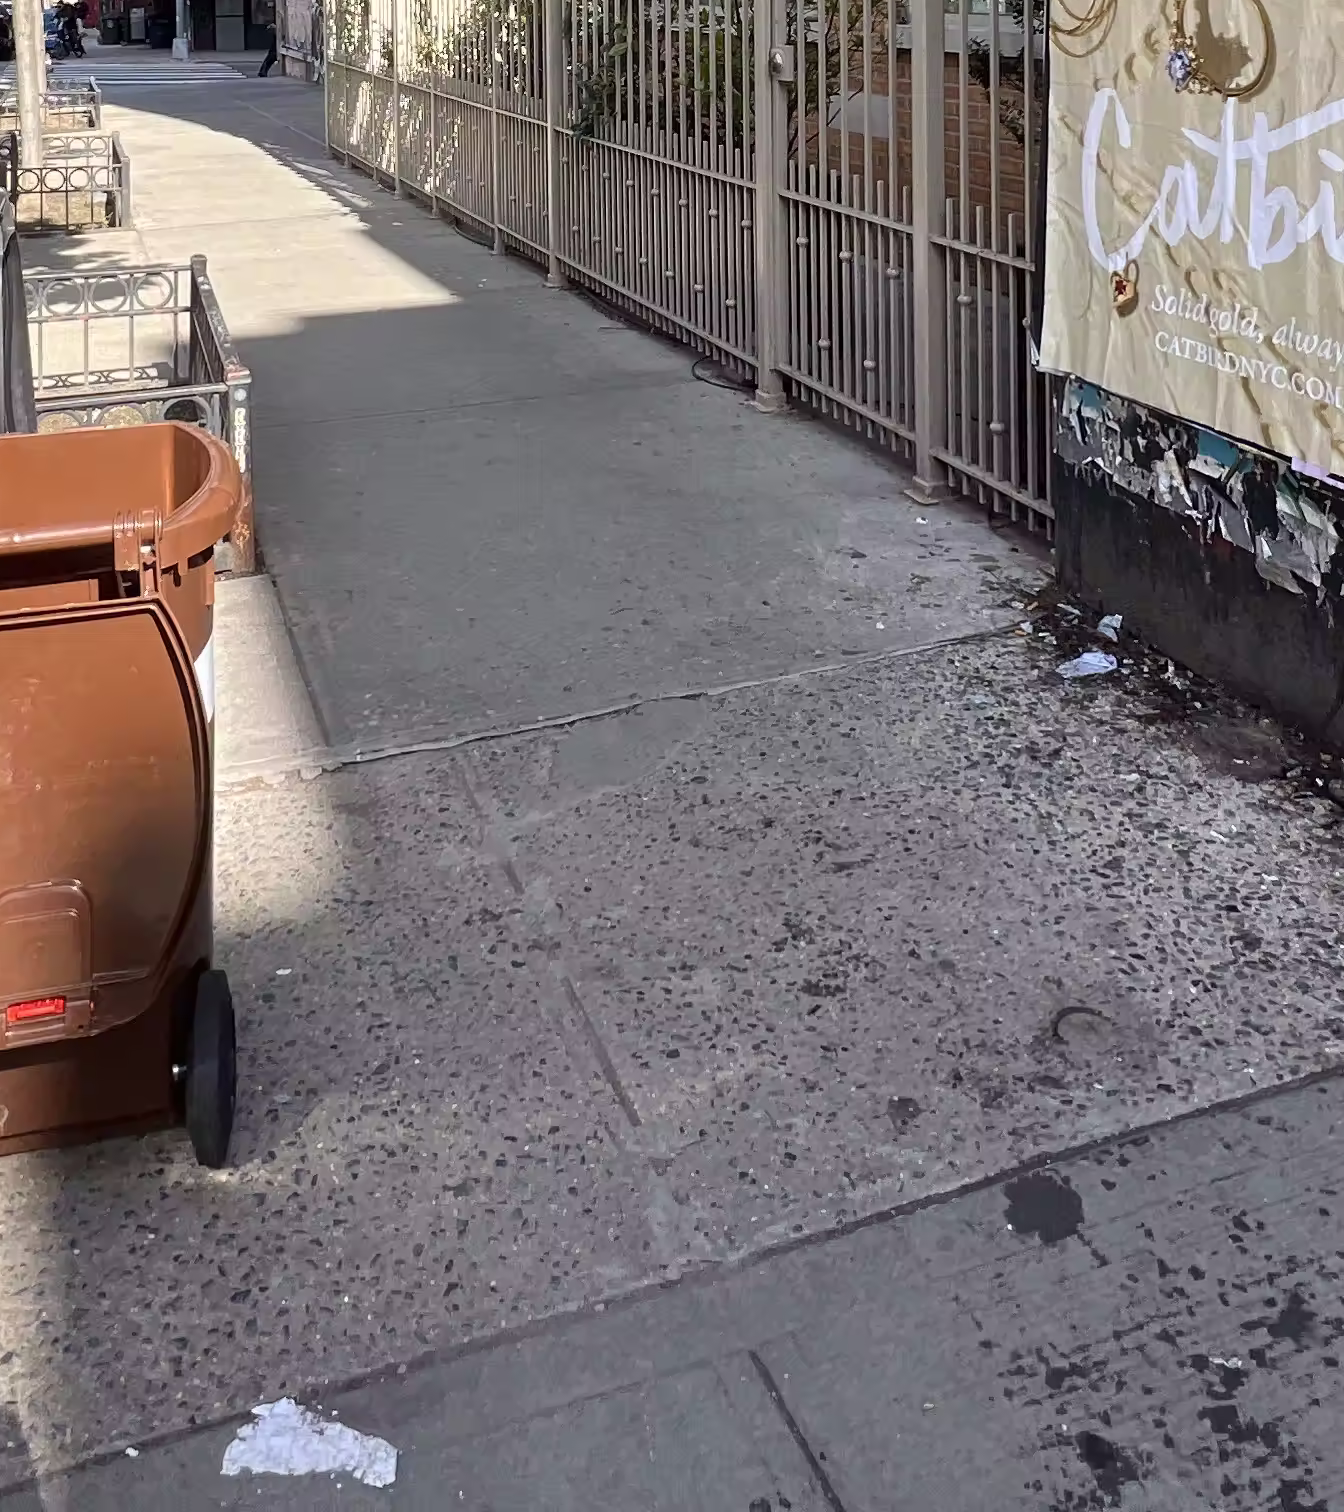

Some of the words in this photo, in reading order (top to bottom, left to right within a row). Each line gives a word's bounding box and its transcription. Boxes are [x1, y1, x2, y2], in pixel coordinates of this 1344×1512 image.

[1151, 284, 1208, 324] Solid
[1208, 304, 1264, 345] gold,
[1154, 331, 1344, 410] CATBIRDNYC.COM
